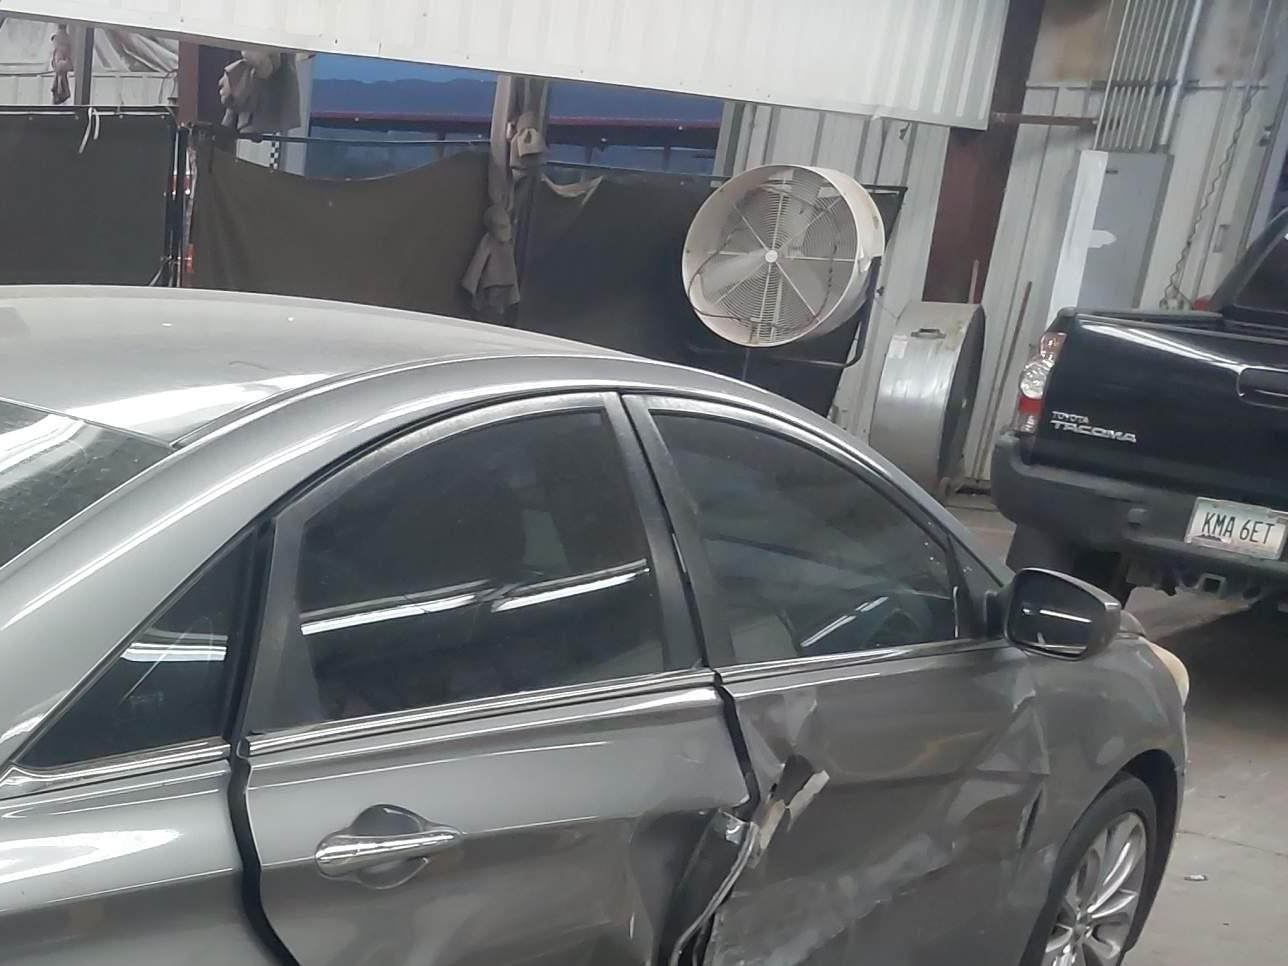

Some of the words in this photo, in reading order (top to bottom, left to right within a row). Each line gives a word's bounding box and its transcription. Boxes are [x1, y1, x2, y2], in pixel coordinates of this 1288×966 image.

[1052, 411, 1090, 423] TOYOTA
[1050, 420, 1137, 443] TACOMA
[1201, 511, 1234, 539] KMA
[1239, 521, 1275, 545] 6ET
